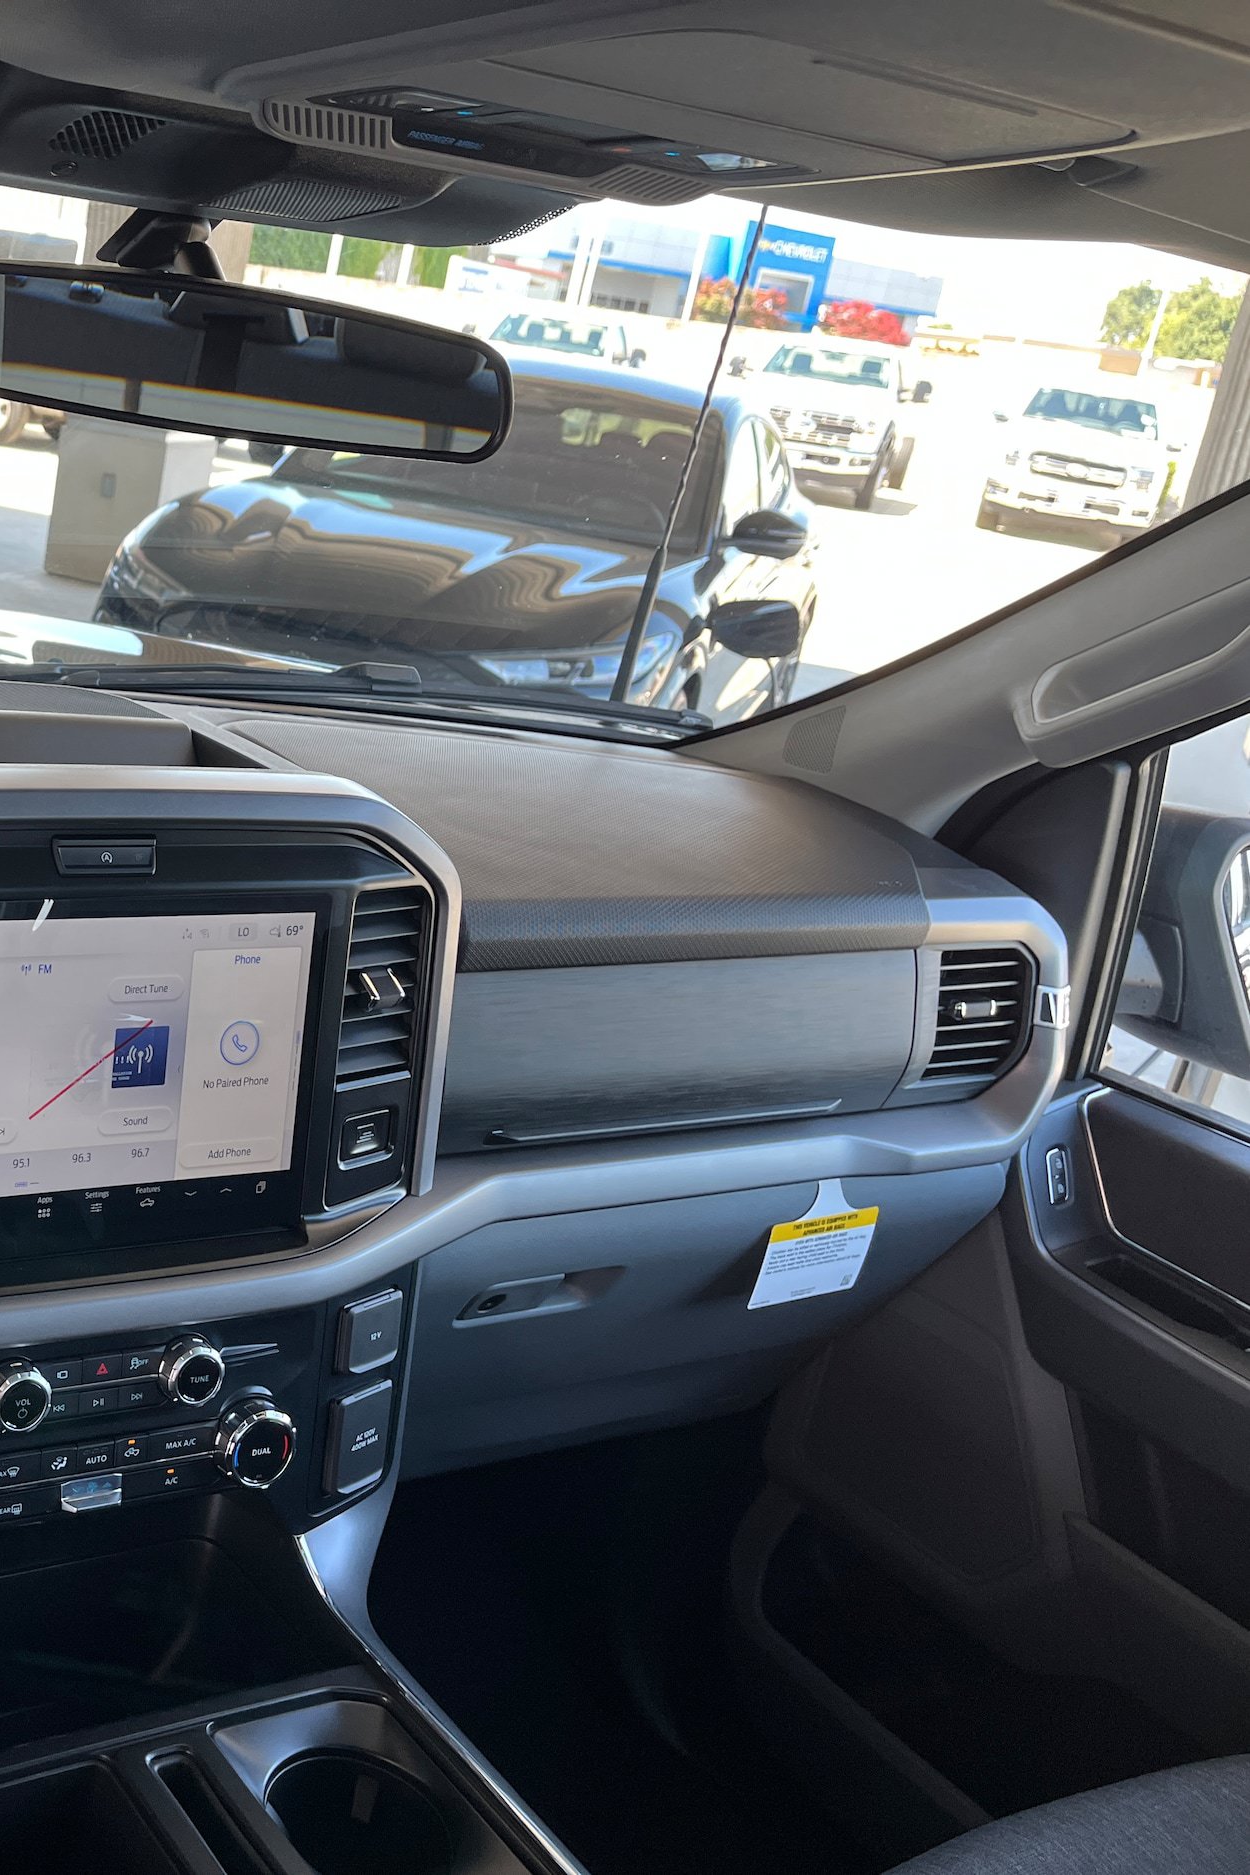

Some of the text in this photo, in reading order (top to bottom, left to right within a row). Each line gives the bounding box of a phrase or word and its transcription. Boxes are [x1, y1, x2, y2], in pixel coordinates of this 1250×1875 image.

[238, 927, 249, 937] LO
[234, 954, 261, 965] Phone
[38, 964, 52, 974] FM
[124, 984, 168, 995] Direct Tune
[203, 1076, 269, 1089] No Paired Phone
[123, 1116, 148, 1127] Sound
[72, 1152, 92, 1164] 96.3
[131, 1148, 150, 1159] 96.7
[207, 1148, 251, 1159] Add Phone
[12, 1158, 30, 1169] 95.1
[85, 1190, 110, 1200] Settings
[135, 1186, 161, 1195] Features
[37, 1195, 53, 1205] Apps
[190, 1375, 210, 1384] TUNE
[15, 1398, 31, 1407] VOL
[165, 1438, 197, 1450] MAX A/C
[367, 1434, 379, 1445] MAX
[251, 1447, 272, 1457] DUAL
[85, 1455, 107, 1465] AUTO
[165, 1476, 178, 1485] A/C
